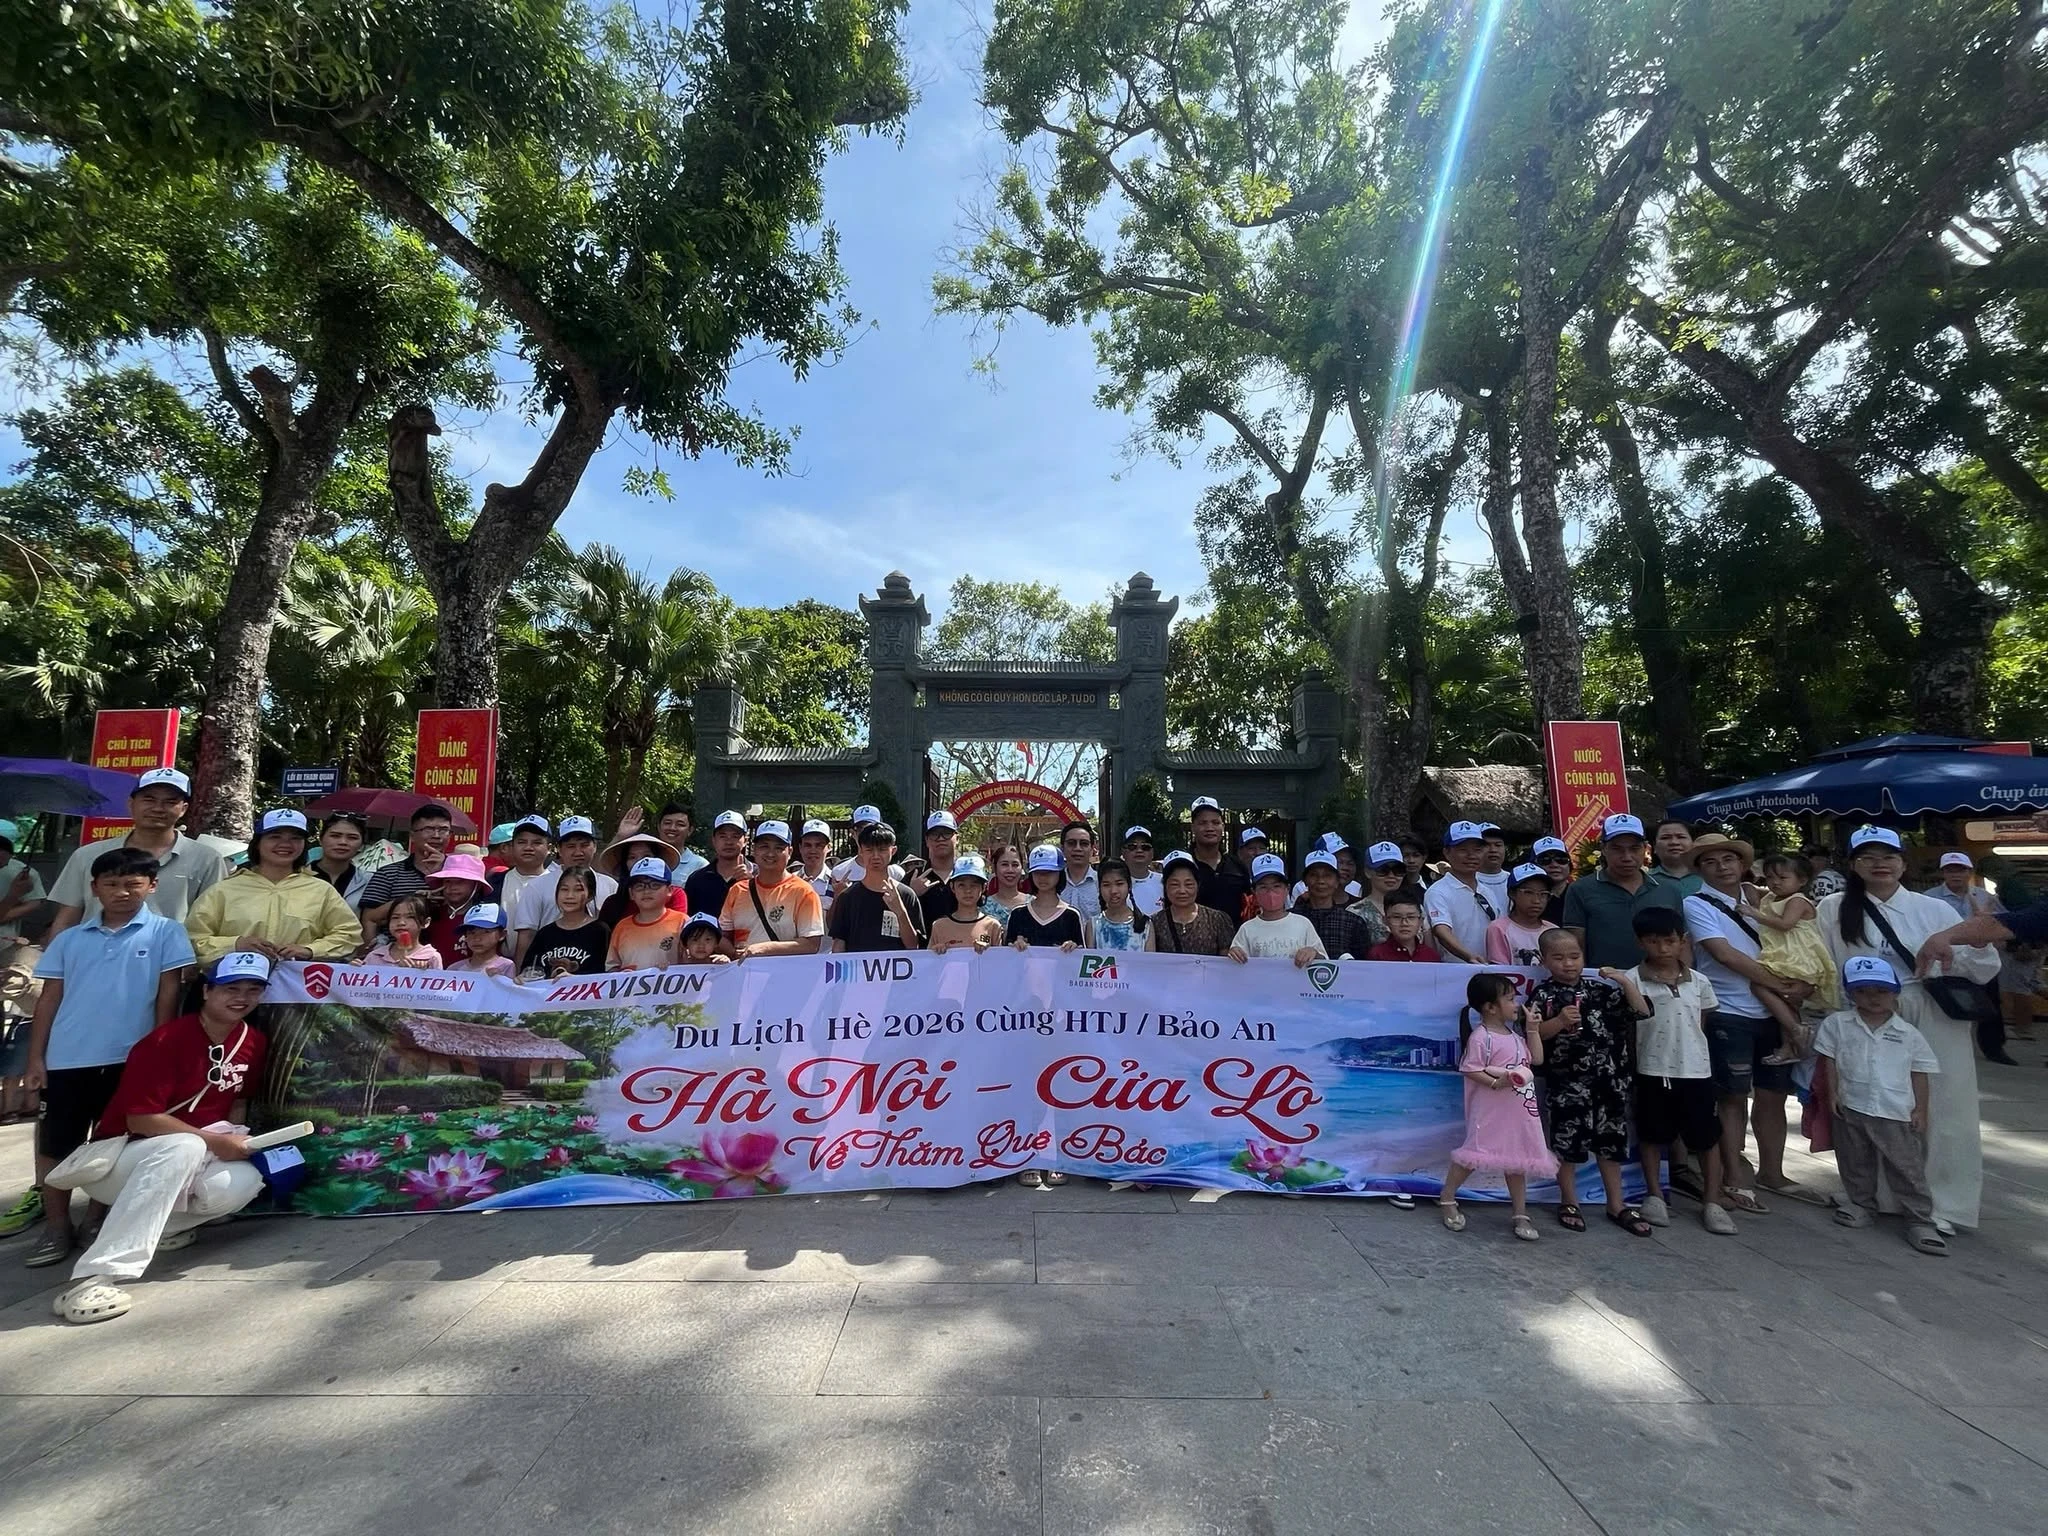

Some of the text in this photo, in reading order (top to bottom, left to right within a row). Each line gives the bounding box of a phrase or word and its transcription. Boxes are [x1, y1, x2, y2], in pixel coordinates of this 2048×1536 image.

[940, 689, 969, 702] KHÔNG
[107, 736, 152, 752] CHỦ TỊCH
[439, 736, 468, 758] ĐẢNG
[96, 754, 158, 768] HỒ CHÍ MINH
[1574, 748, 1602, 763] NƯỚC
[425, 763, 477, 789] CỘNG SẢN
[1565, 769, 1617, 788] CỘNG HÒA
[1576, 792, 1589, 807] XÃ
[1756, 793, 1820, 809] photobooth
[1980, 784, 2048, 802] Chụp ản
[862, 958, 913, 982] WD
[1079, 954, 1118, 980] BA
[338, 971, 475, 992] NHÀ AN TOÀN
[545, 972, 709, 1002] HIKVISION
[1095, 981, 1130, 989] SECURITY
[350, 990, 454, 1002] Leading security solutions
[674, 1006, 1277, 1051] Du Lịch Hè 2026 Cùng HTJ / Bảo An
[620, 1066, 777, 1132] Hà
[787, 1057, 957, 1123] Nội
[1036, 1054, 1191, 1112] Cửa
[1202, 1056, 1323, 1144] Lò
[783, 1119, 1168, 1172] Về Thăm Quê Bác
